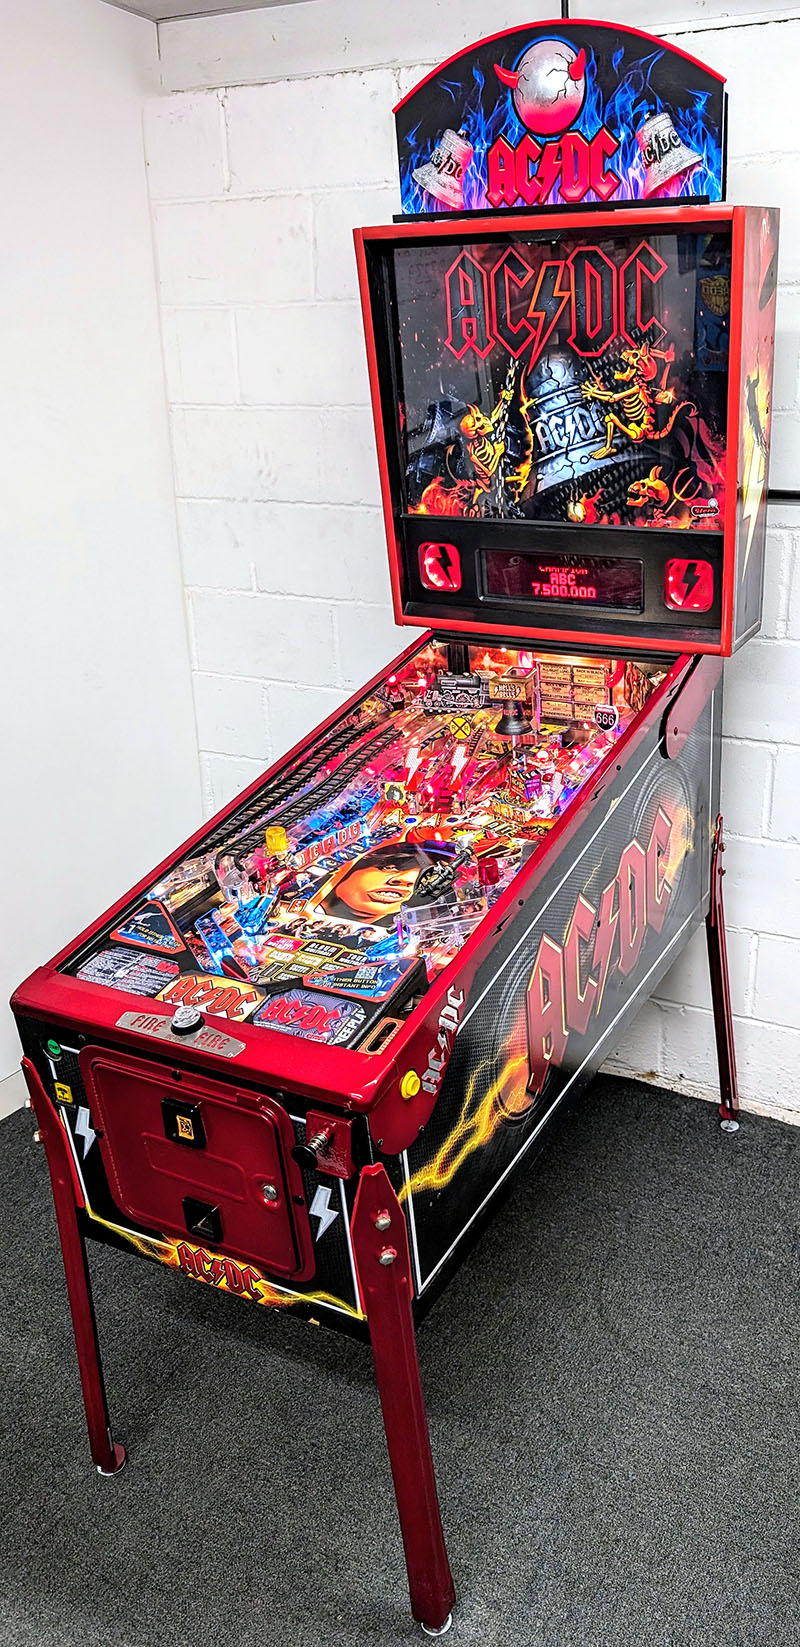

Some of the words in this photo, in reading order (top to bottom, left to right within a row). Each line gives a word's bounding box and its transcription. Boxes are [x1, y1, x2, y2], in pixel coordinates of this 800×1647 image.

[549, 573, 577, 586] ABC
[596, 712, 615, 726] 666
[309, 943, 338, 951] ALBUM
[346, 953, 367, 963] TOUR
[130, 1014, 166, 1032] FIRE
[327, 1008, 367, 1045] REEPLAY
[194, 1032, 231, 1050] FIRE
